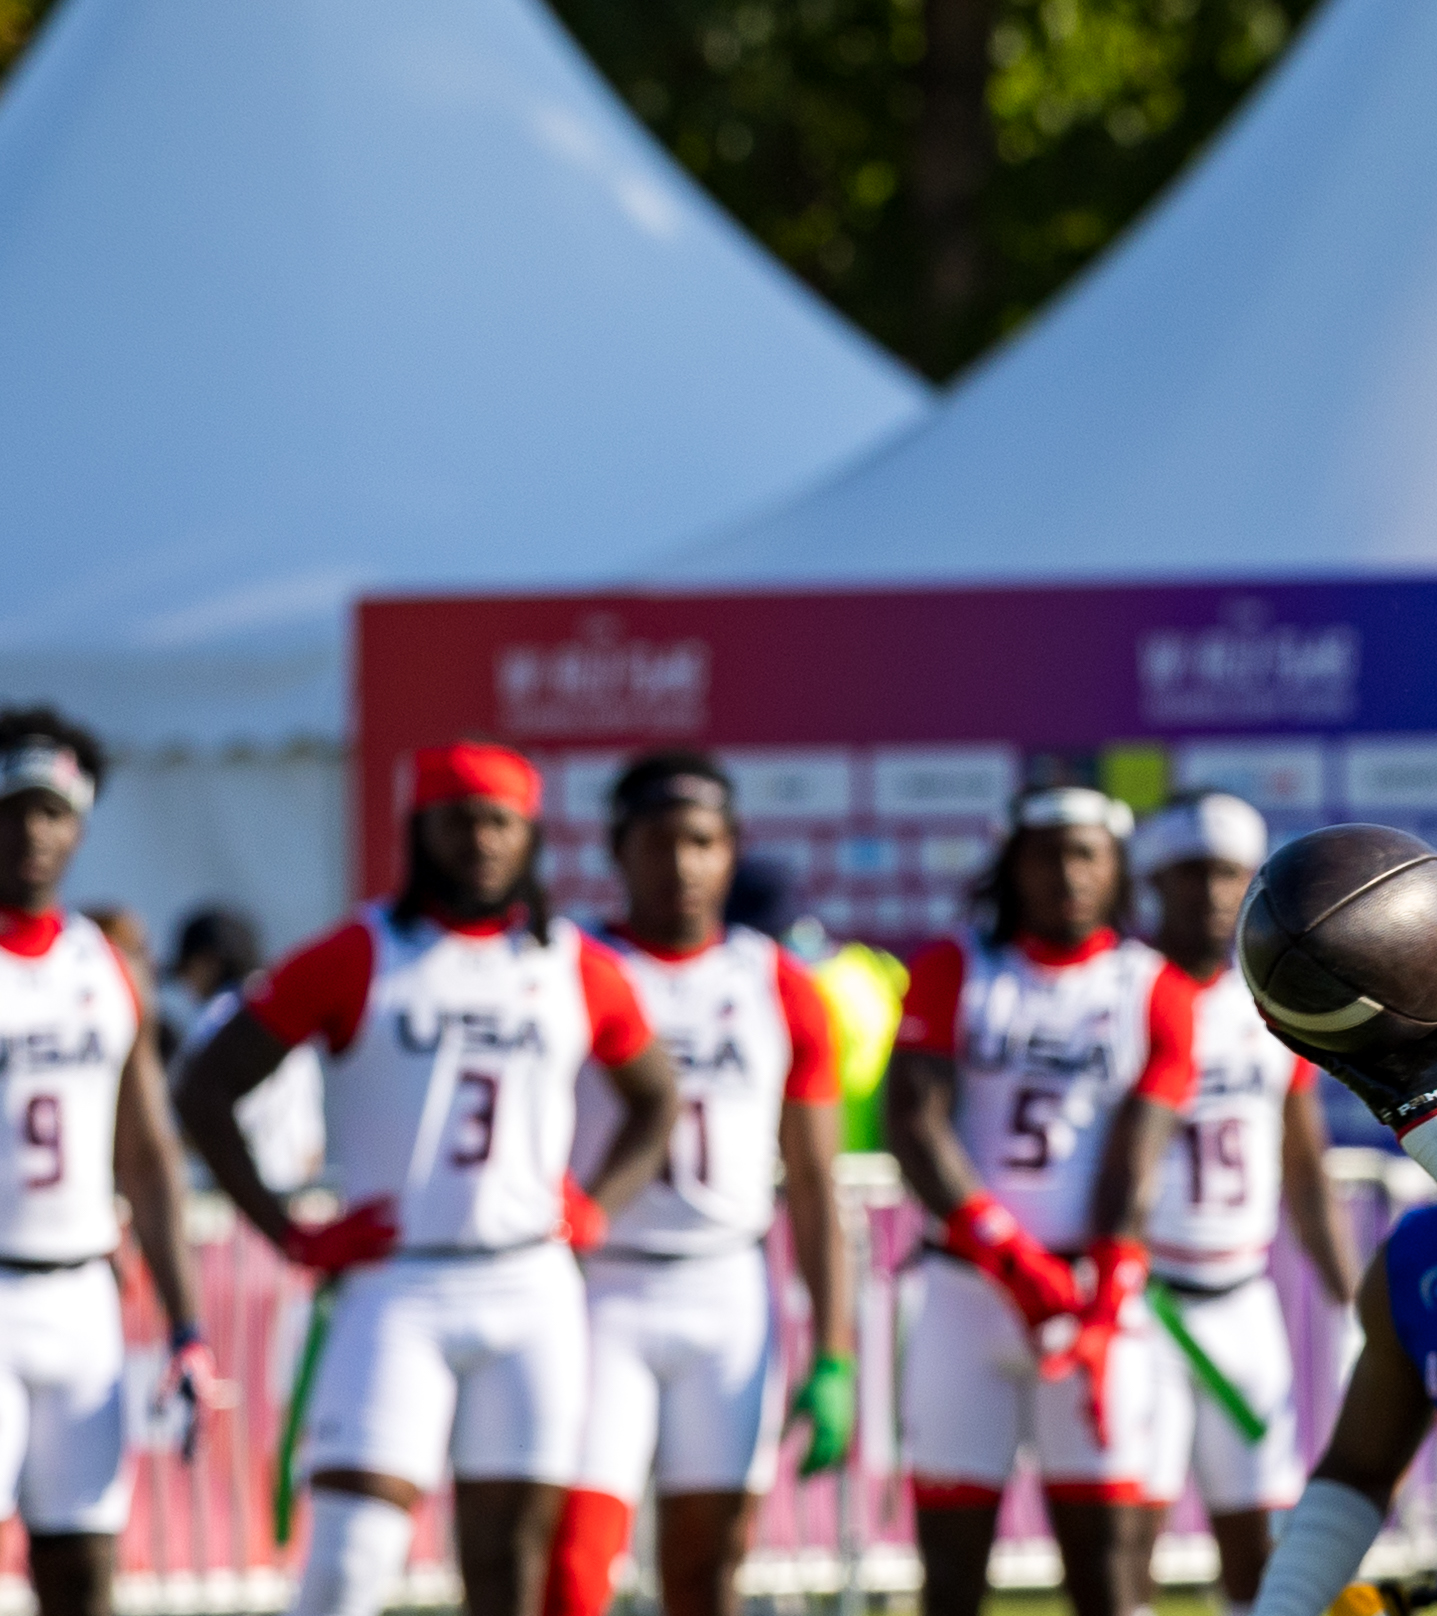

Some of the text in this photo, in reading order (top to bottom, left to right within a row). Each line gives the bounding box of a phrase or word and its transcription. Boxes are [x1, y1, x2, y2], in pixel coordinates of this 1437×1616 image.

[395, 1006, 548, 1057] USA
[660, 1032, 748, 1076] SA
[963, 1028, 1112, 1080] USA
[25, 1093, 62, 1188] 9
[452, 1070, 498, 1168] 3
[1004, 1088, 1062, 1170] 5
